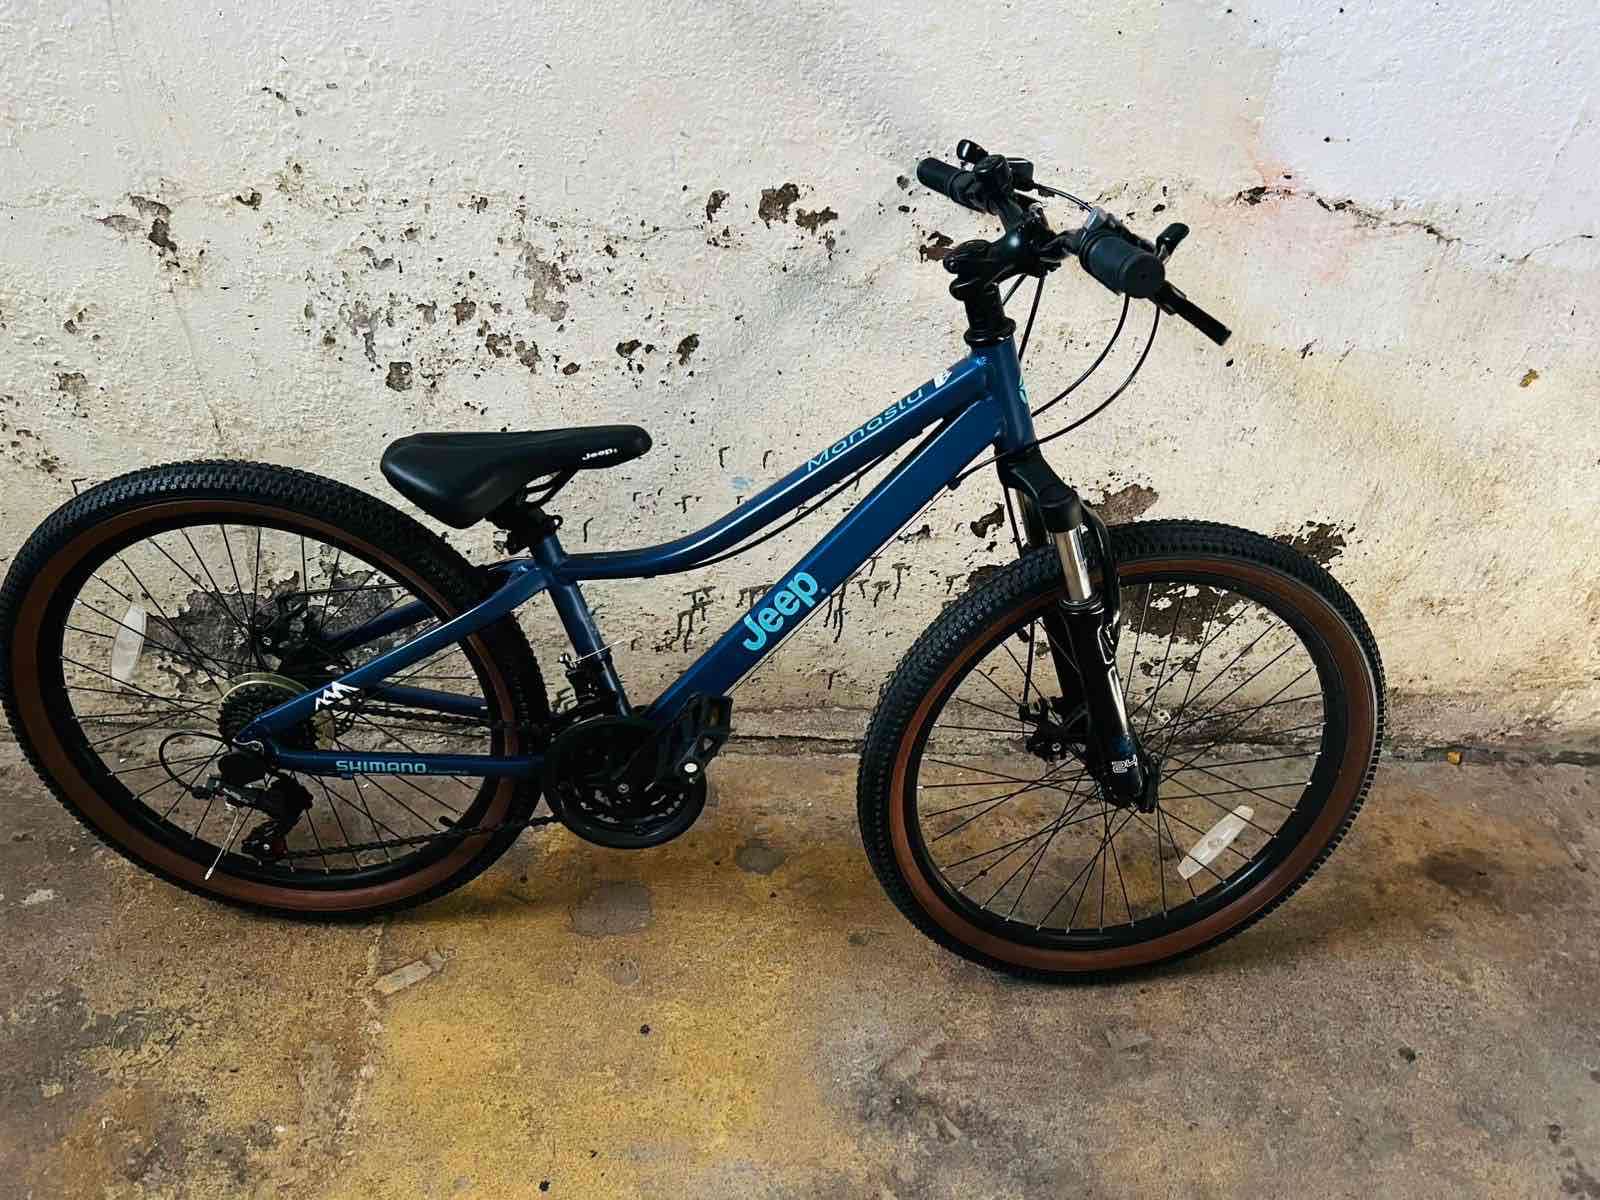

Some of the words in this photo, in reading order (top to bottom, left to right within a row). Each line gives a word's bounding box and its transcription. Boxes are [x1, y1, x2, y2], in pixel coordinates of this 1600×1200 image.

[806, 389, 923, 472] Manaslu
[581, 448, 613, 461] Jeep
[742, 571, 818, 651] Jeep
[336, 760, 427, 774] SHIMANO
